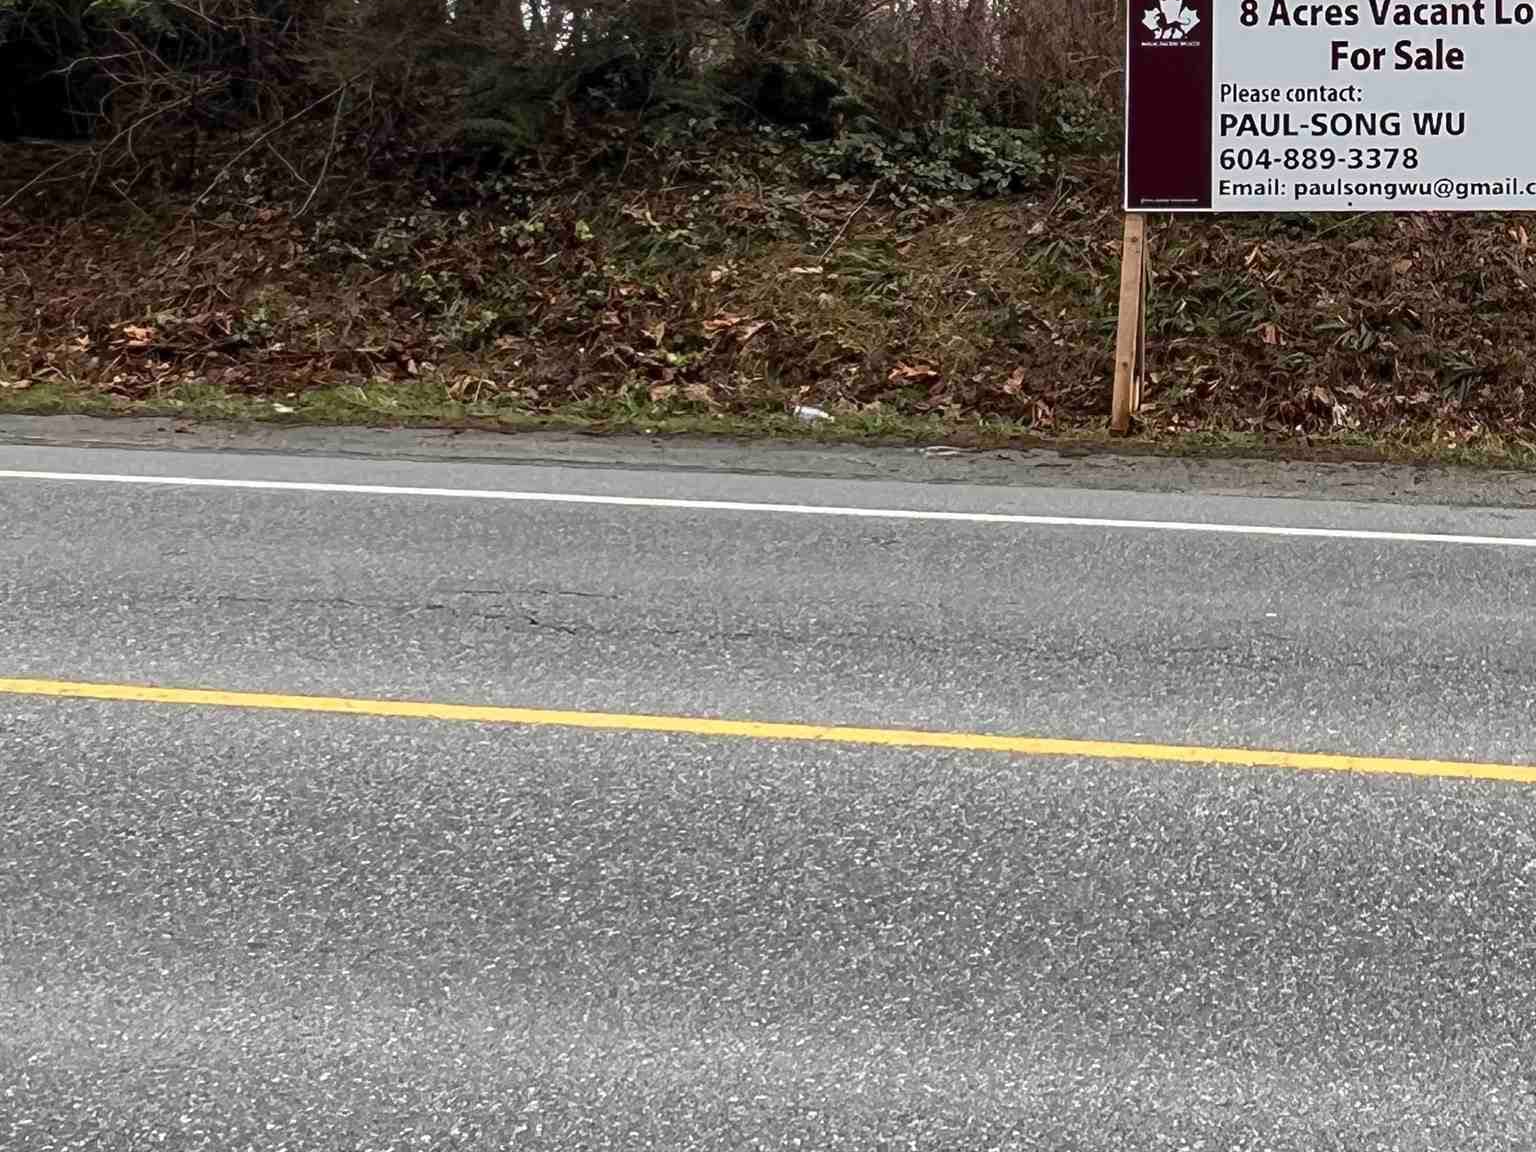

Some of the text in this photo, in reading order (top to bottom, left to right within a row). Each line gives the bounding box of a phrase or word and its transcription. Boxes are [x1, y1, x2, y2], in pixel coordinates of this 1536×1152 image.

[1331, 39, 1465, 70] For Sale
[1220, 84, 1362, 103] Please contact:
[1220, 112, 1465, 136] PAUL-SONG WU
[1219, 148, 1418, 170] 604-889-3378
[1219, 178, 1286, 196] Email:
